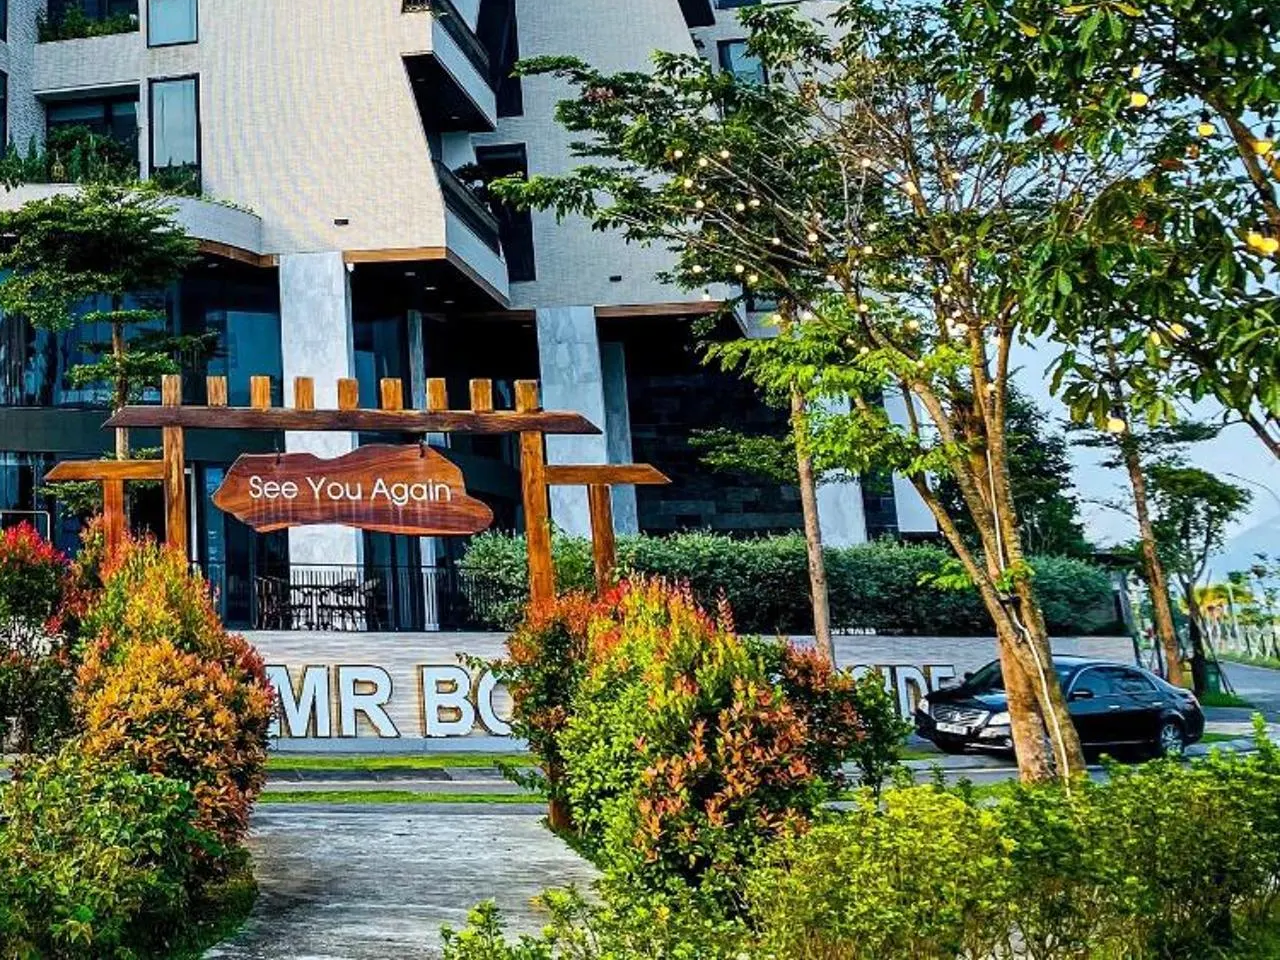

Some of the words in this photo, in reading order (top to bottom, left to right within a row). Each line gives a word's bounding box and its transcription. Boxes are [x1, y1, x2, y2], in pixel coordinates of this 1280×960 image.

[249, 475, 298, 499] See
[306, 476, 362, 501] You
[371, 478, 452, 506] Again
[265, 664, 402, 739] MR
